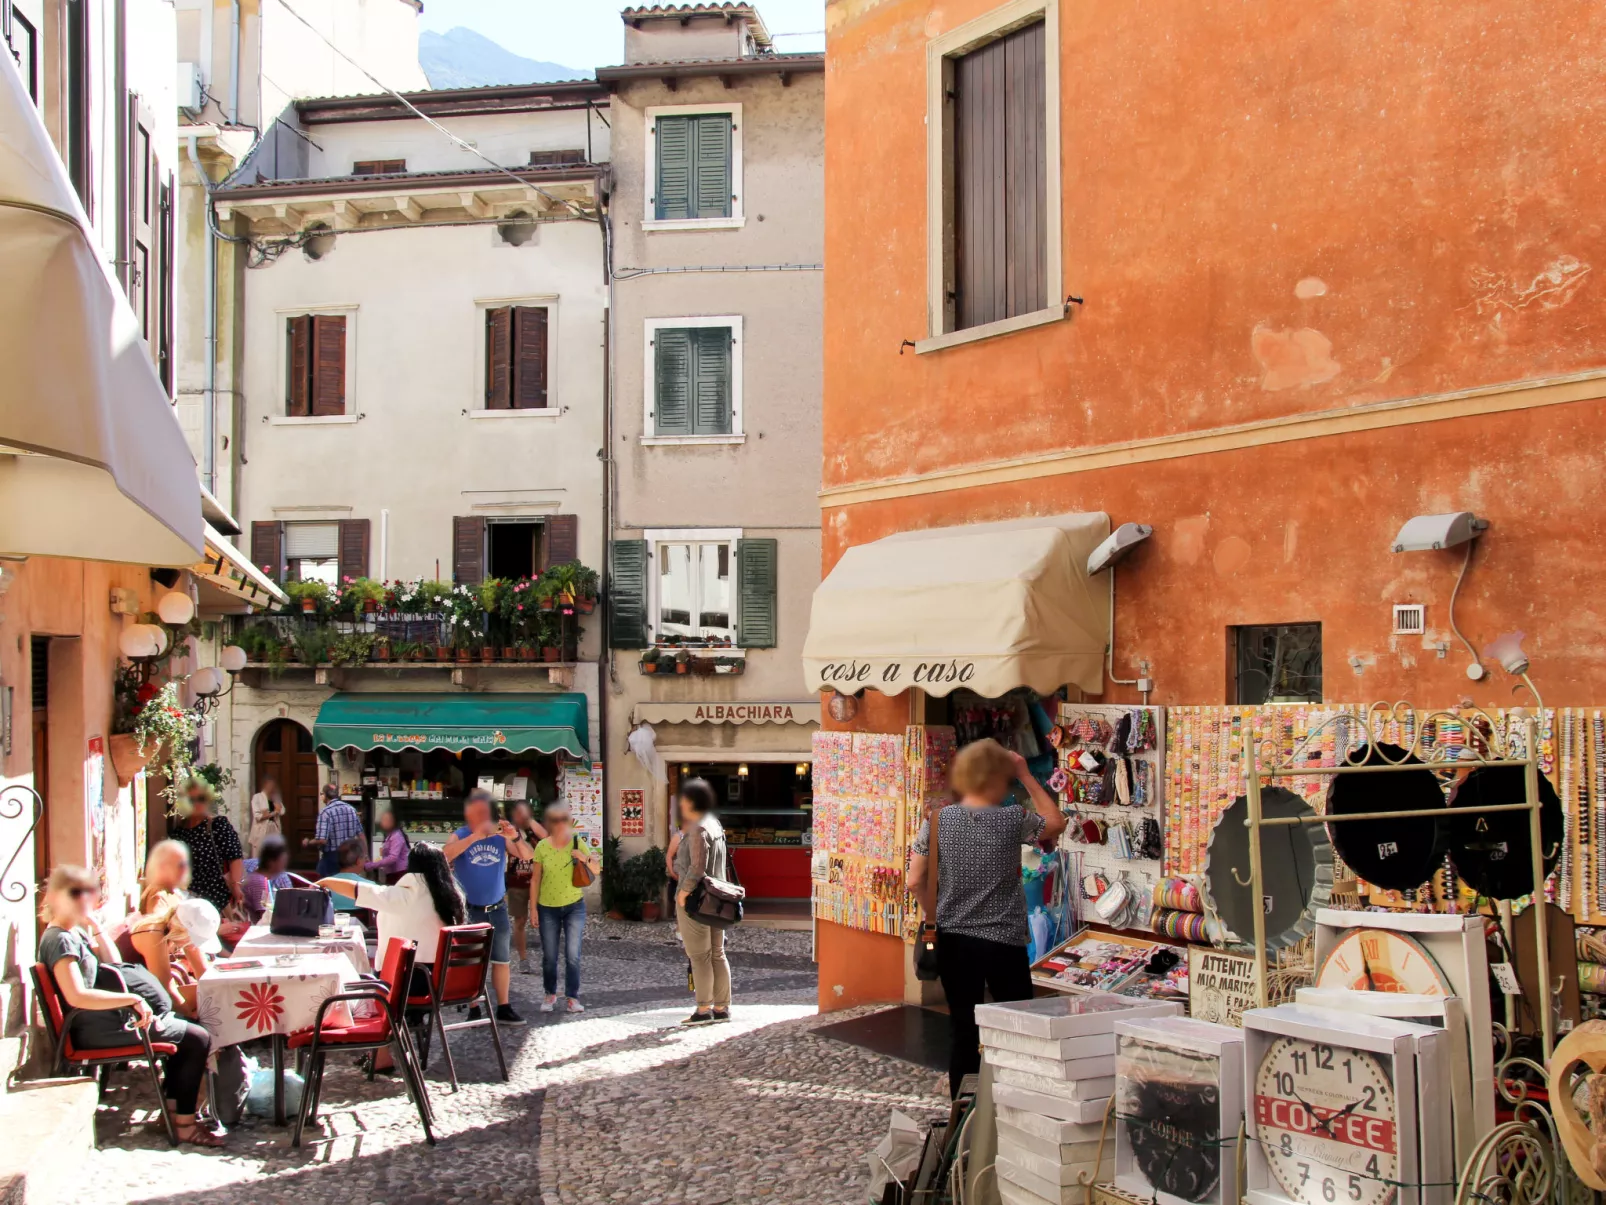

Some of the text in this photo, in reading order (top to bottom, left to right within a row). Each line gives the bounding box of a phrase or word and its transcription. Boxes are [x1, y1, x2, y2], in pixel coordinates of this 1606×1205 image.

[820, 659, 975, 683] cose a caso
[695, 706, 794, 719] ALBACHIARA
[1202, 955, 1254, 979] ATTENTI!
[1197, 973, 1257, 997] MIO MARITO
[1290, 1050, 1308, 1076] 11
[1311, 1043, 1335, 1071] 12
[1273, 1070, 1294, 1097] 10
[1342, 1058, 1352, 1084] 1
[1362, 1085, 1378, 1112] 2
[1150, 1119, 1193, 1149] COFFEE
[1271, 1101, 1385, 1150] COFFEE
[1280, 1133, 1293, 1158] 8
[1297, 1162, 1310, 1187] 7
[1365, 1153, 1380, 1180] 4
[1322, 1177, 1336, 1203] 6
[1348, 1175, 1362, 1201] 5
